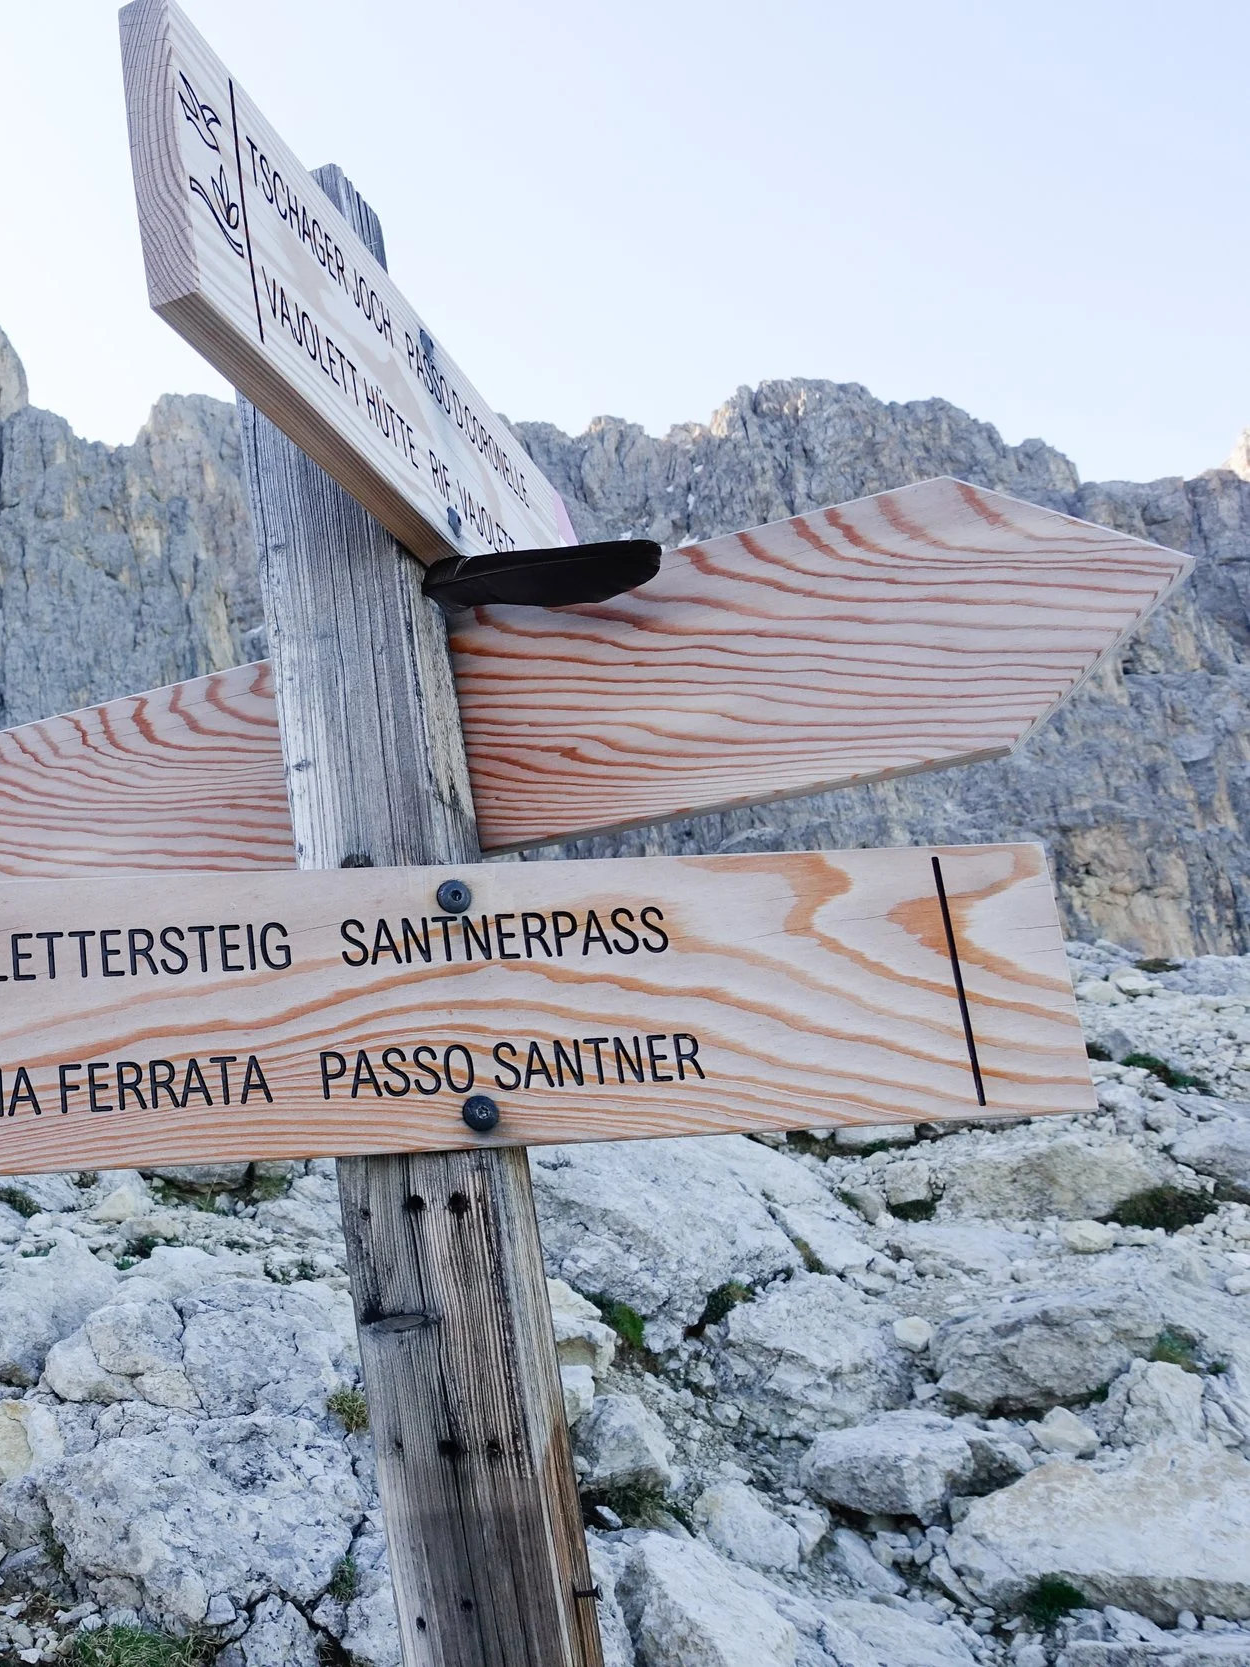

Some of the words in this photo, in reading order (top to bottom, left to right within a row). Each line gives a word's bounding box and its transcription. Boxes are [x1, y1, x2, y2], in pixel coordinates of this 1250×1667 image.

[245, 135, 349, 295] TSCHAGER
[352, 268, 394, 348] JOCH
[405, 331, 451, 415] PASSO
[261, 266, 360, 406] VAJOLETT
[364, 377, 419, 469] HÜTTE
[341, 906, 670, 967] SANTNERPASS
[58, 1055, 273, 1114] FERRATA
[320, 1044, 475, 1100] PASSO
[494, 1033, 705, 1092] SANTNER
